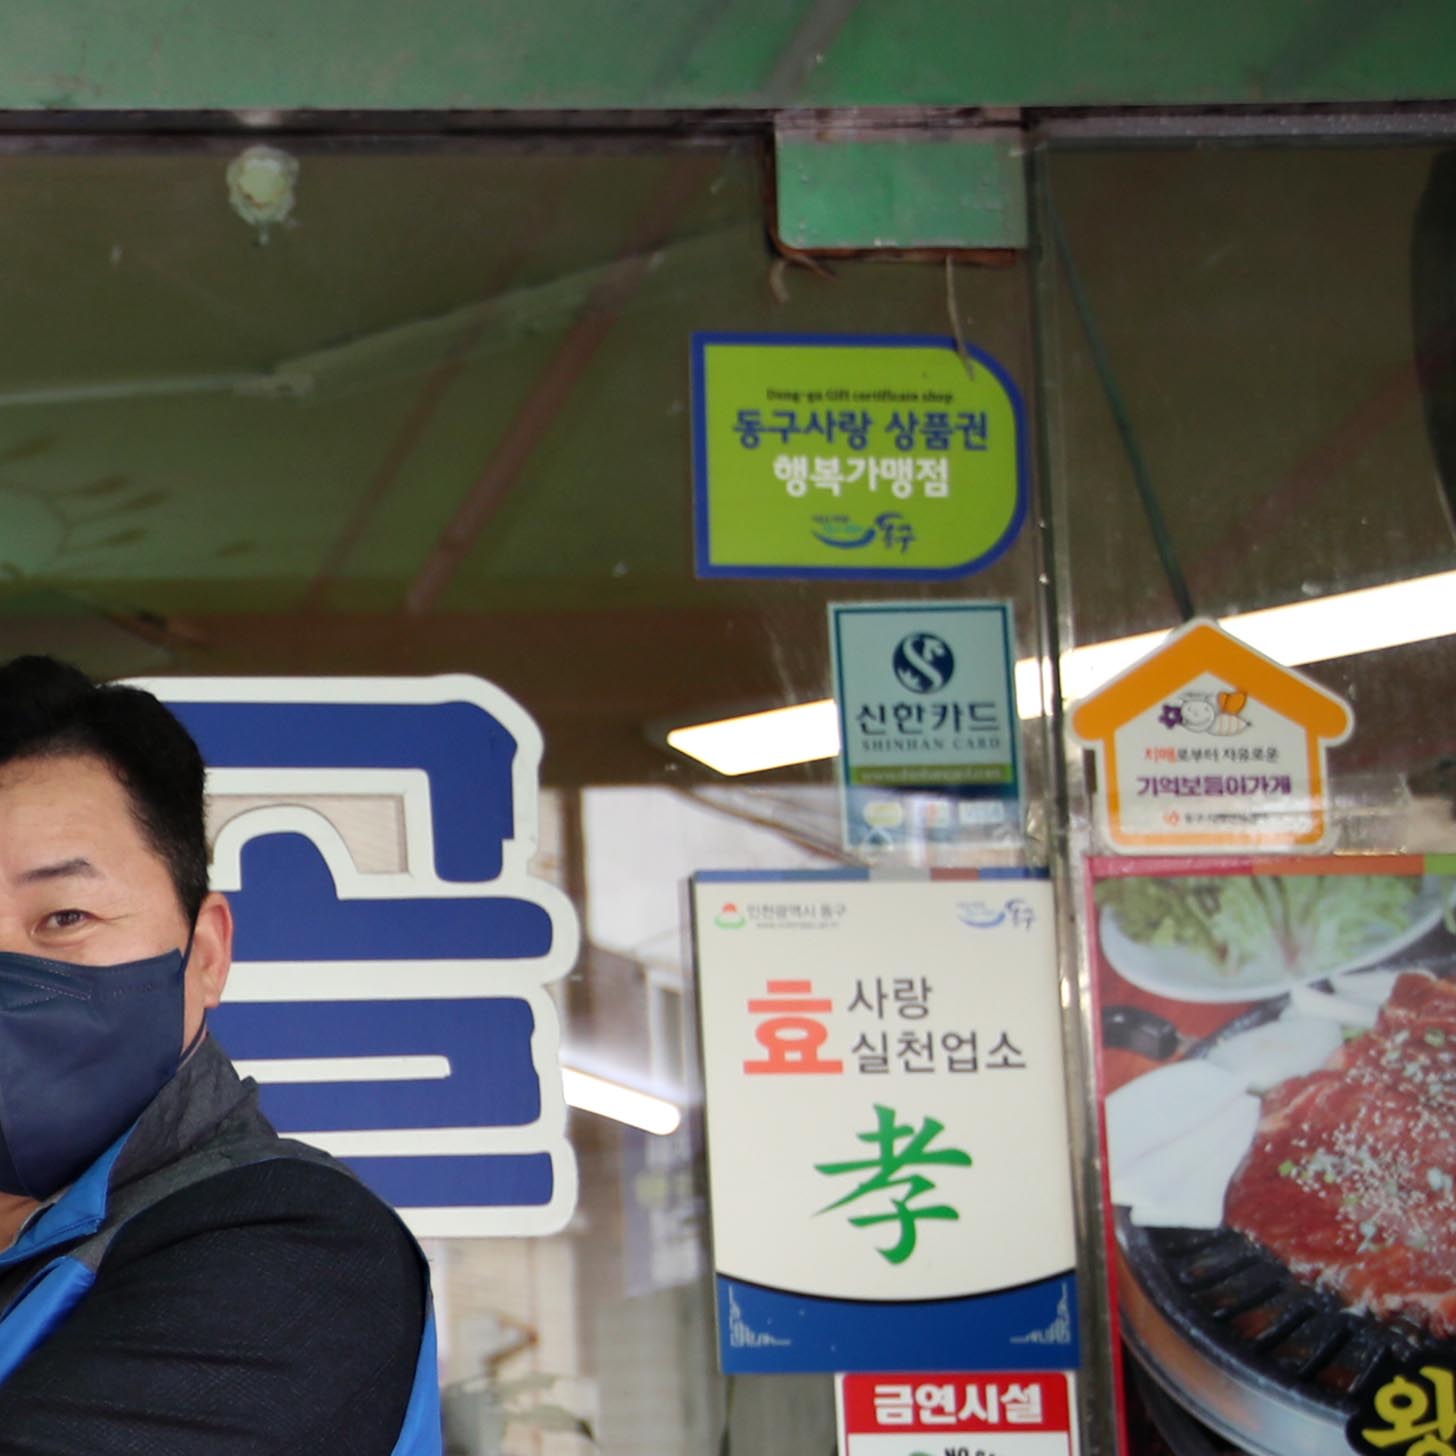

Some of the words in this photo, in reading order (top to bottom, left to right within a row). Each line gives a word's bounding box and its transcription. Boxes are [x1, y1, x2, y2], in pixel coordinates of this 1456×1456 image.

[732, 408, 873, 450] 동구사랑
[885, 408, 989, 451] 상품권
[772, 453, 950, 499] 행복가맹점
[857, 700, 1001, 735] 신한카드
[862, 738, 945, 751] SHINHAN
[952, 737, 1000, 750] CARD
[1145, 747, 1218, 762] 치매로부터
[1222, 747, 1280, 763] 자유로운
[743, 979, 845, 1076] 효
[847, 976, 933, 1021] 사랑
[850, 1030, 1029, 1076] 실천업소
[811, 1103, 974, 1266] 孝
[873, 1383, 1044, 1425] 금연시설
